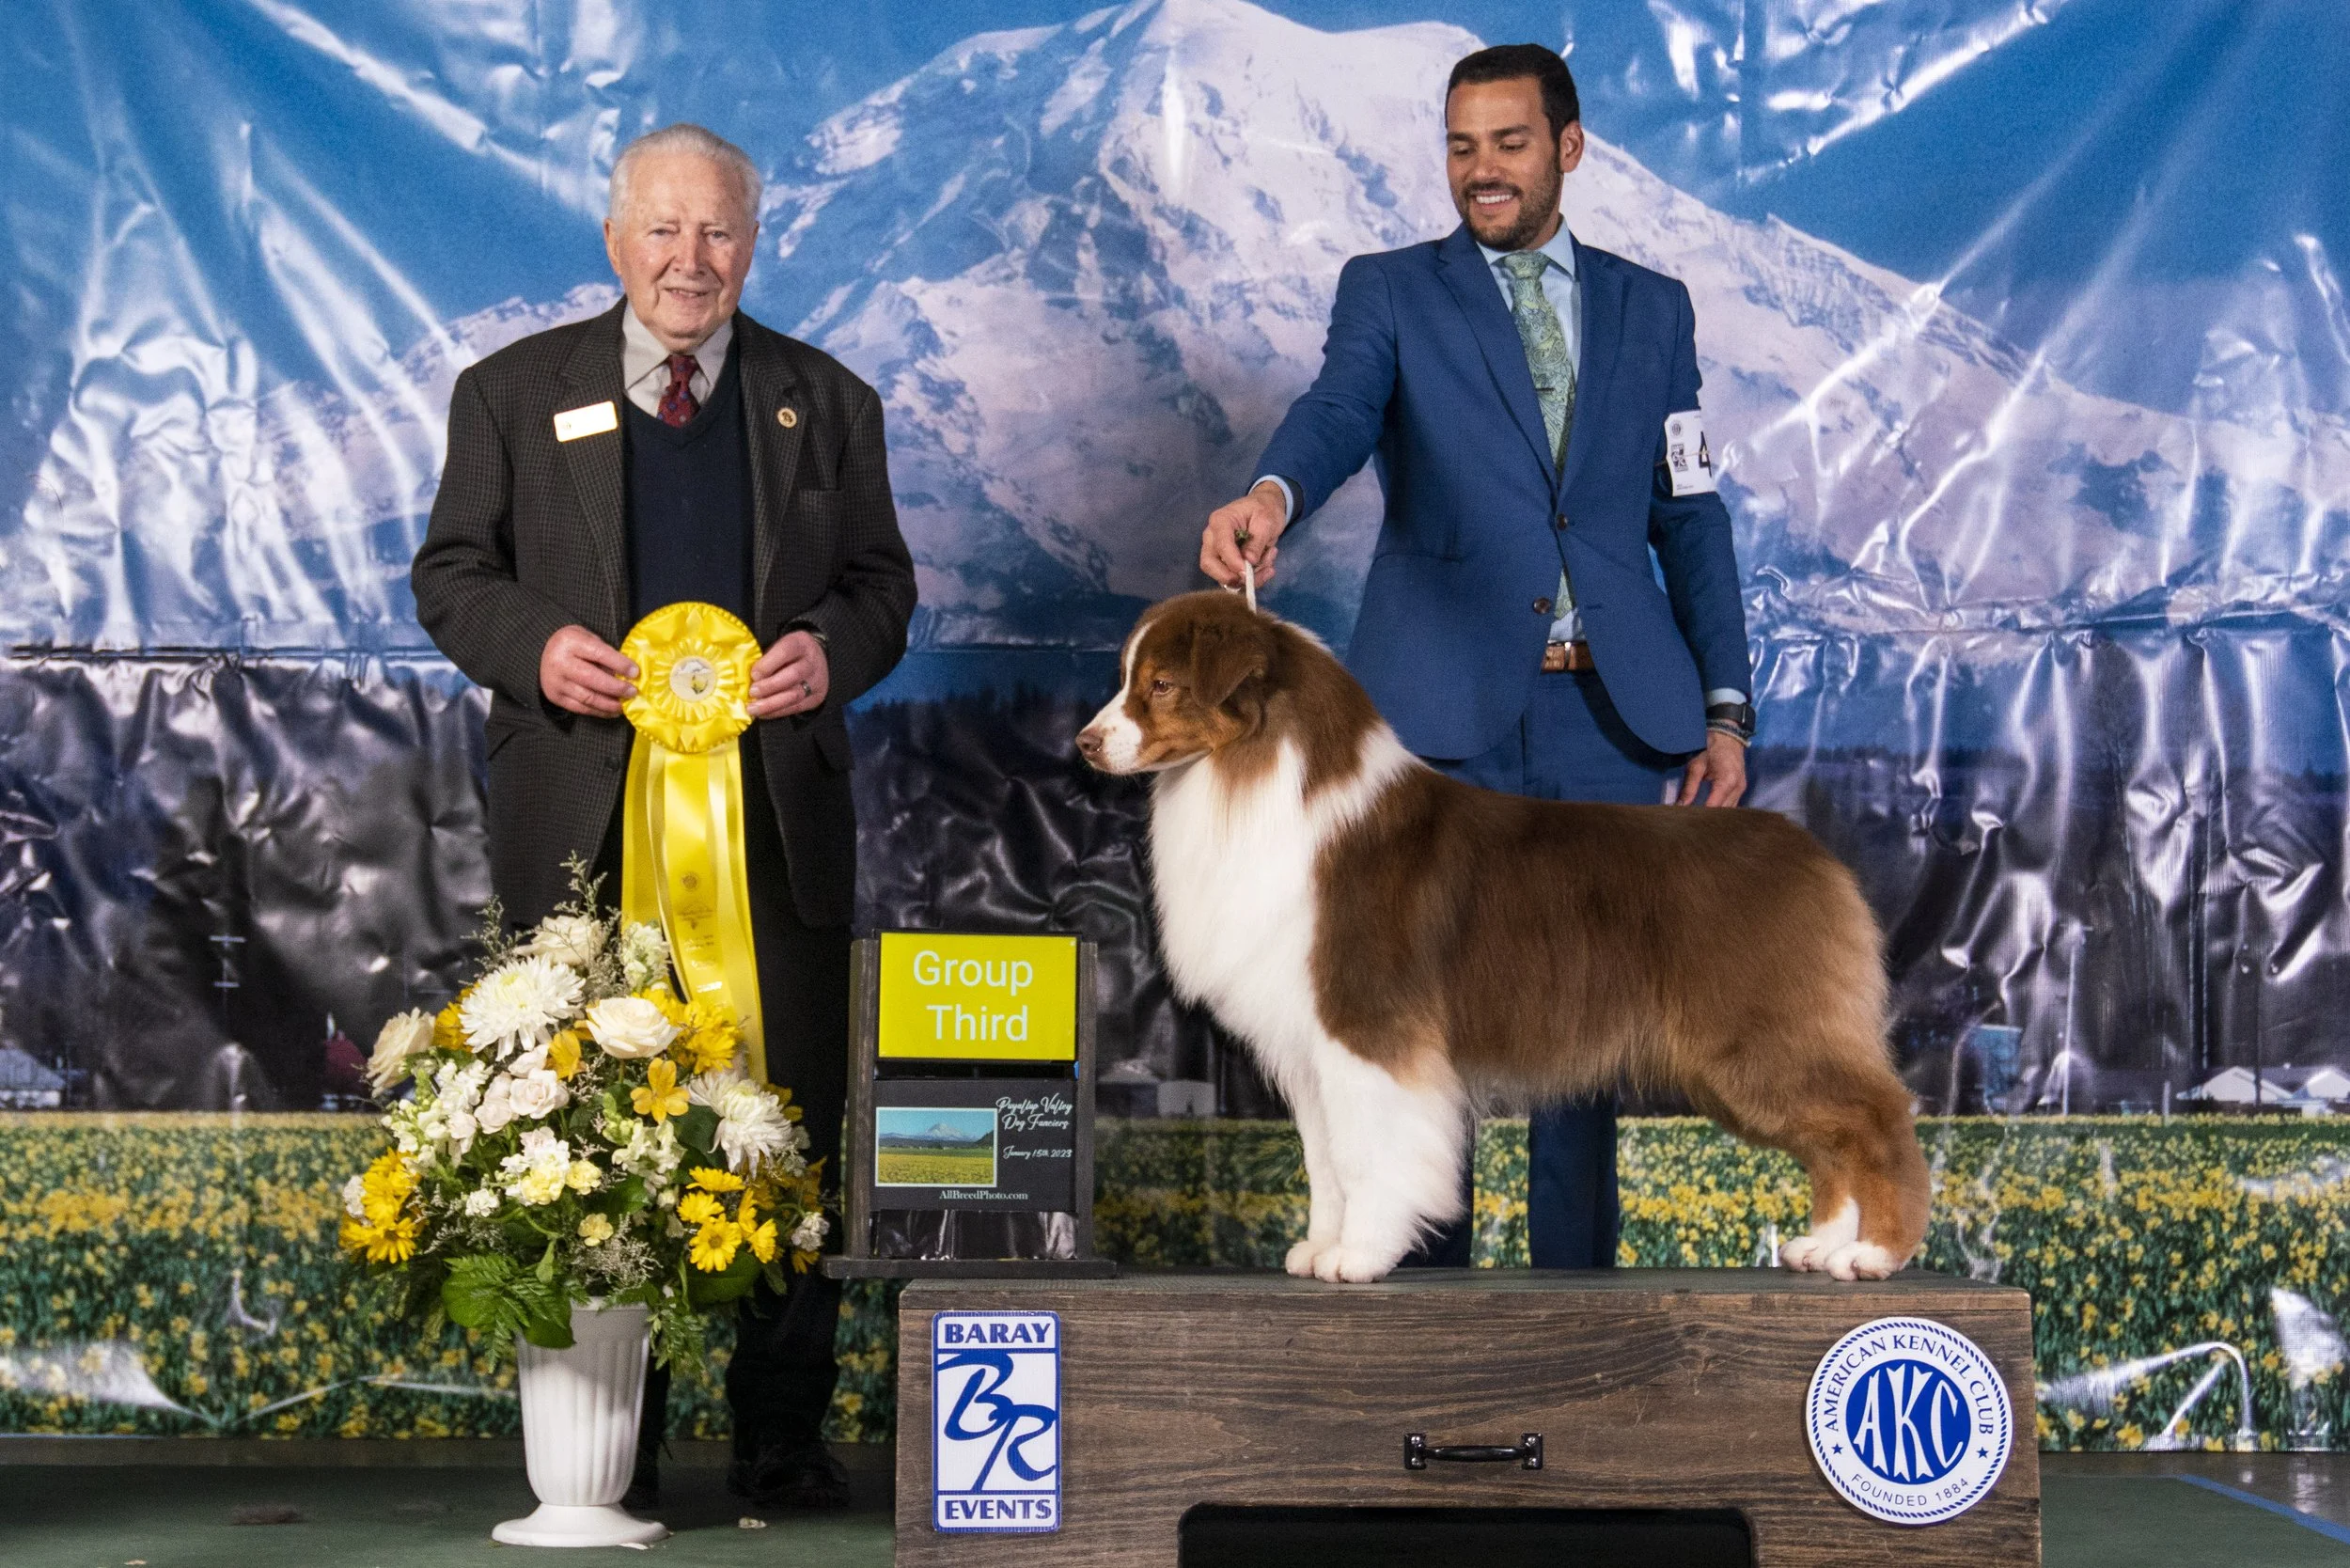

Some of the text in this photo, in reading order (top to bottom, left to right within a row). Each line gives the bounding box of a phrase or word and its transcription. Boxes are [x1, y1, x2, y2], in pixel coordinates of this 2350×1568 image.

[913, 949, 1033, 996] Group
[926, 1004, 1028, 1042] Third
[995, 1092, 1073, 1115] Puyallup Valley
[1002, 1113, 1069, 1132] Dog Fanciers
[1003, 1145, 1031, 1160] January
[1050, 1149, 1073, 1158] 2023
[939, 1189, 1028, 1200] AllBreedPhoto.com
[944, 1323, 1051, 1344] BARAY
[1824, 1334, 1994, 1435] AMERICAN KENNEL CLUB
[1853, 1363, 1964, 1482] AKC
[1851, 1473, 1969, 1507] FOUNDED 1884
[944, 1498, 1052, 1520] EVENTS
